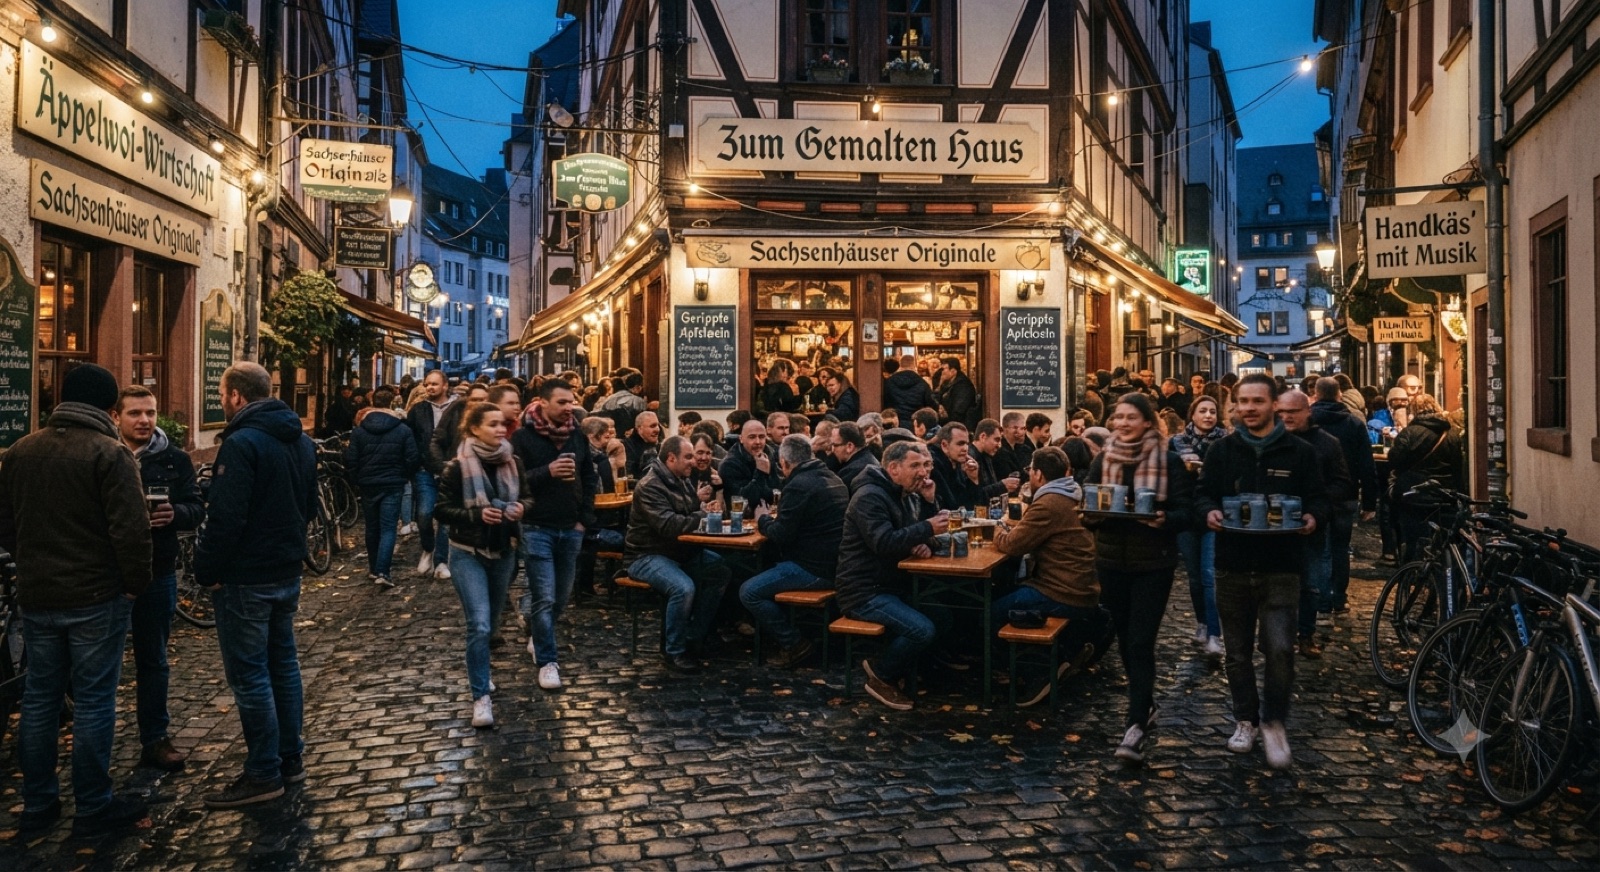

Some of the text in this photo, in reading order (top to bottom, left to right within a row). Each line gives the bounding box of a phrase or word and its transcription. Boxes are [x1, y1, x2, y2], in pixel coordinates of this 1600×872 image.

[36, 56, 215, 205] Äppelwoi-Wirtschaft
[717, 125, 1024, 170] Zum Gemalten Haus
[38, 170, 150, 241] Sachsenhäuser
[152, 214, 201, 257] Originale
[749, 240, 997, 267] Sachsenhäuser Originale
[1376, 241, 1478, 268] mit Musik
[681, 311, 729, 327] Gerippte
